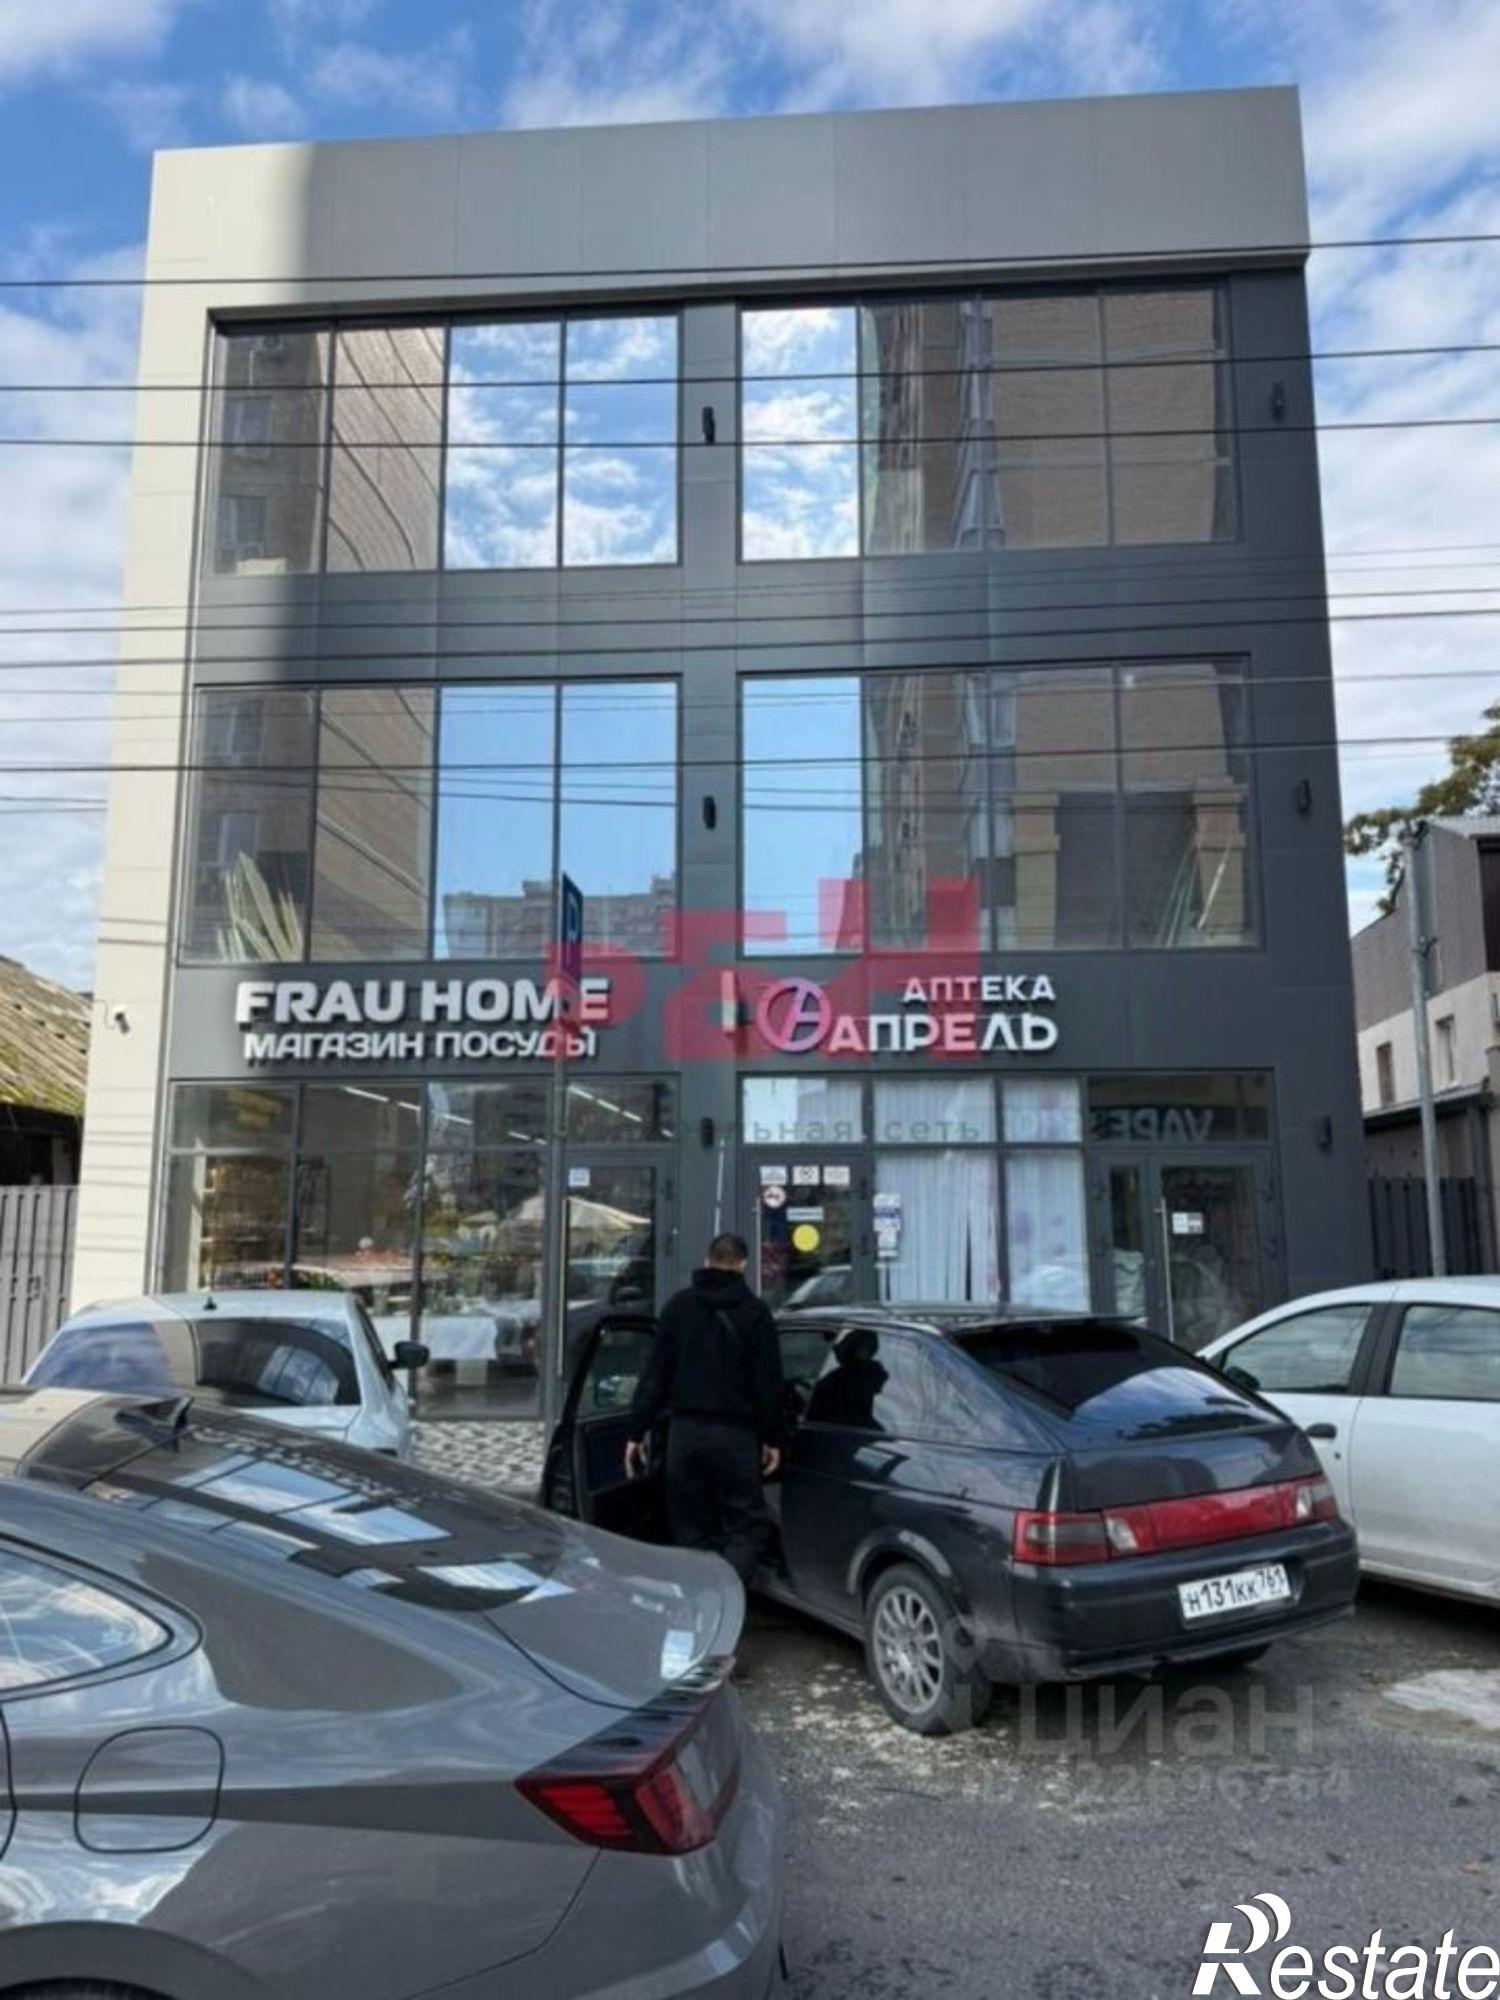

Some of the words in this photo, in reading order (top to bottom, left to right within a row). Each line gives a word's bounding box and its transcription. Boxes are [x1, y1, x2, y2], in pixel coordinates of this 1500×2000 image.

[234, 979, 406, 1024] FRAU
[420, 977, 608, 1021] HOME
[903, 974, 1057, 1003] АПТЕКА
[243, 1031, 419, 1059] МАГАЗИН
[435, 1026, 597, 1058] ПОСУДЫ
[828, 1011, 1059, 1053] АПРЕЛЬ
